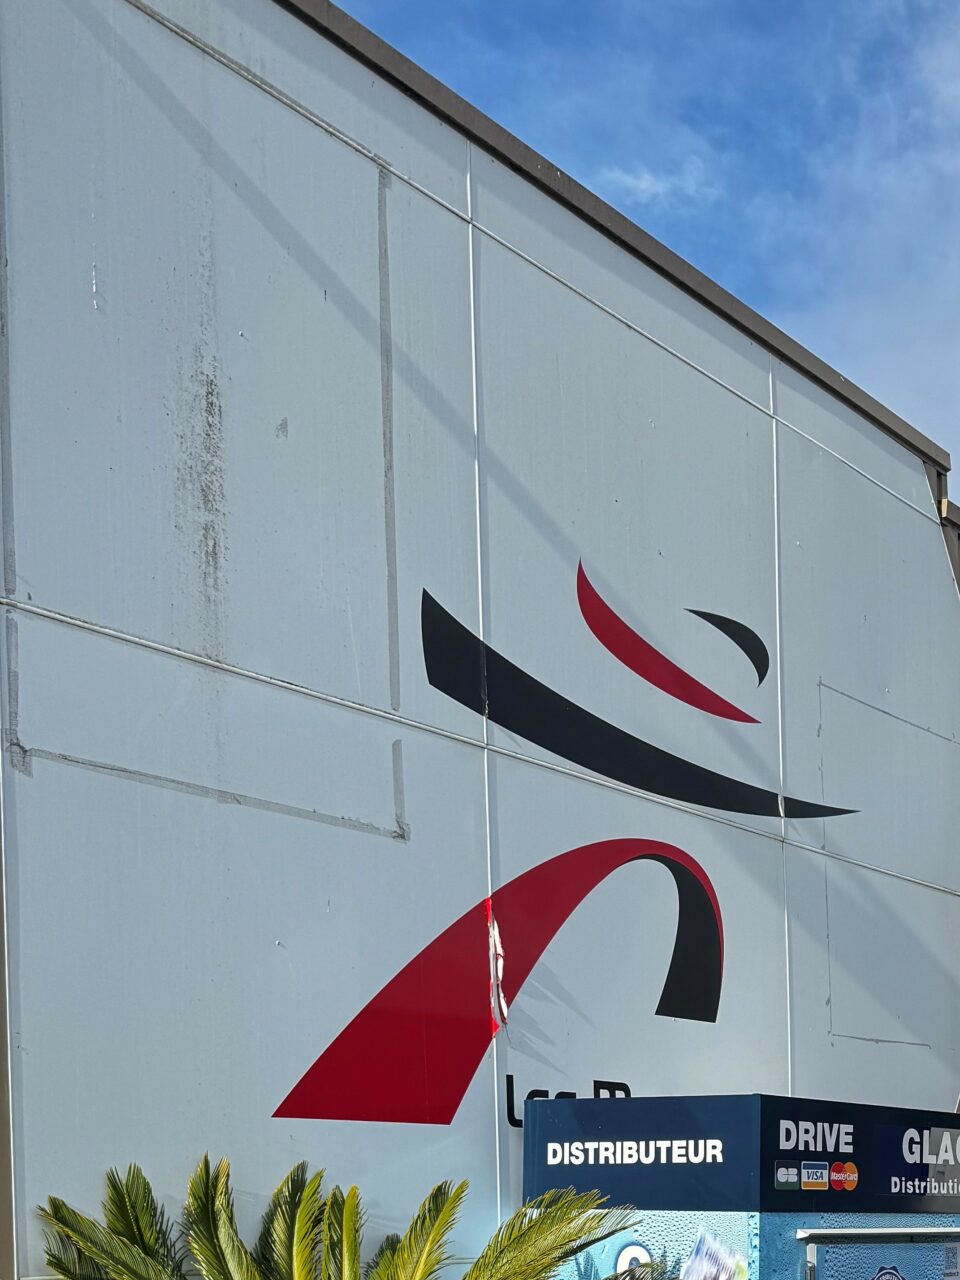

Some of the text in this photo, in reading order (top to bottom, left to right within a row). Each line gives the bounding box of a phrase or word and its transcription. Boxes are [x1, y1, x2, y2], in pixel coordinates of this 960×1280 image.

[779, 1119, 854, 1153] DRIVE
[547, 1139, 723, 1165] DISTRIBUTEUR
[806, 1170, 824, 1181] VISA
[831, 1171, 858, 1181] MasterCard
